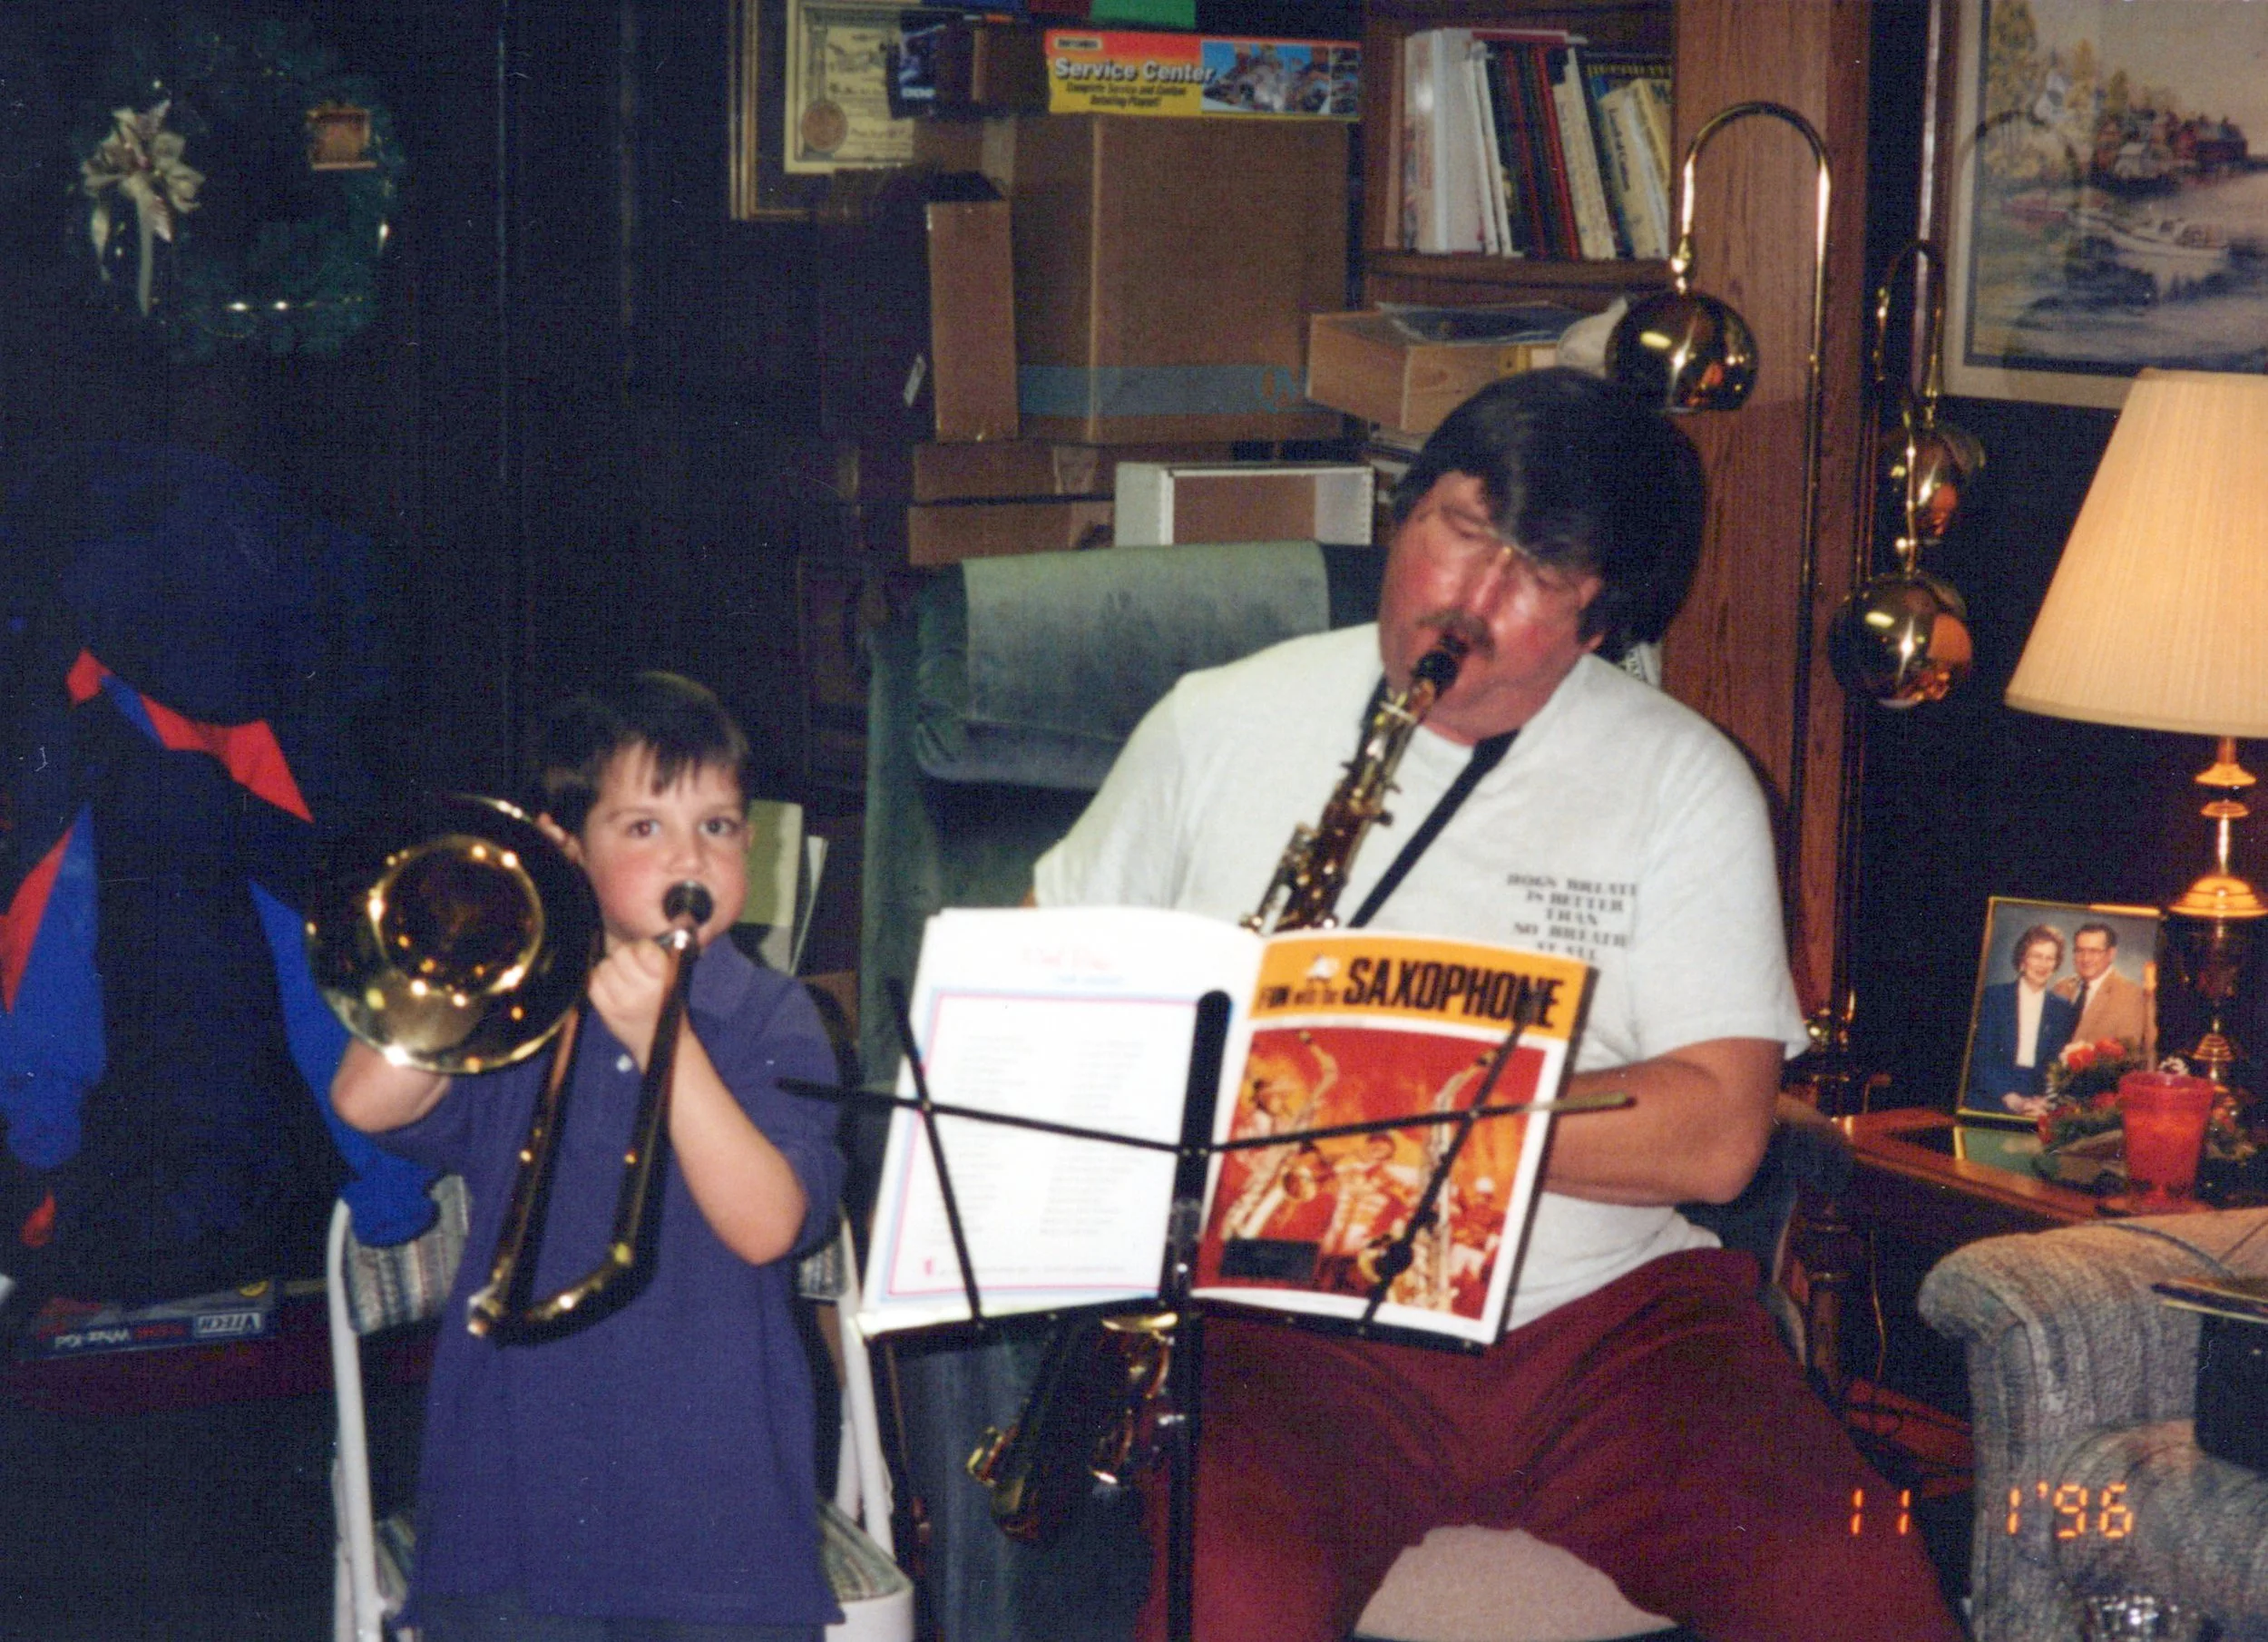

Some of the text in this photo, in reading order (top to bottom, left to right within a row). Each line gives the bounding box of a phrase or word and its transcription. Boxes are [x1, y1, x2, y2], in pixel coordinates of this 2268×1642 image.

[1054, 57, 1215, 83] Service Center
[1549, 892, 1624, 912] BETTER
[1546, 907, 1598, 925] THAN
[1513, 921, 1628, 948] NO BREATH
